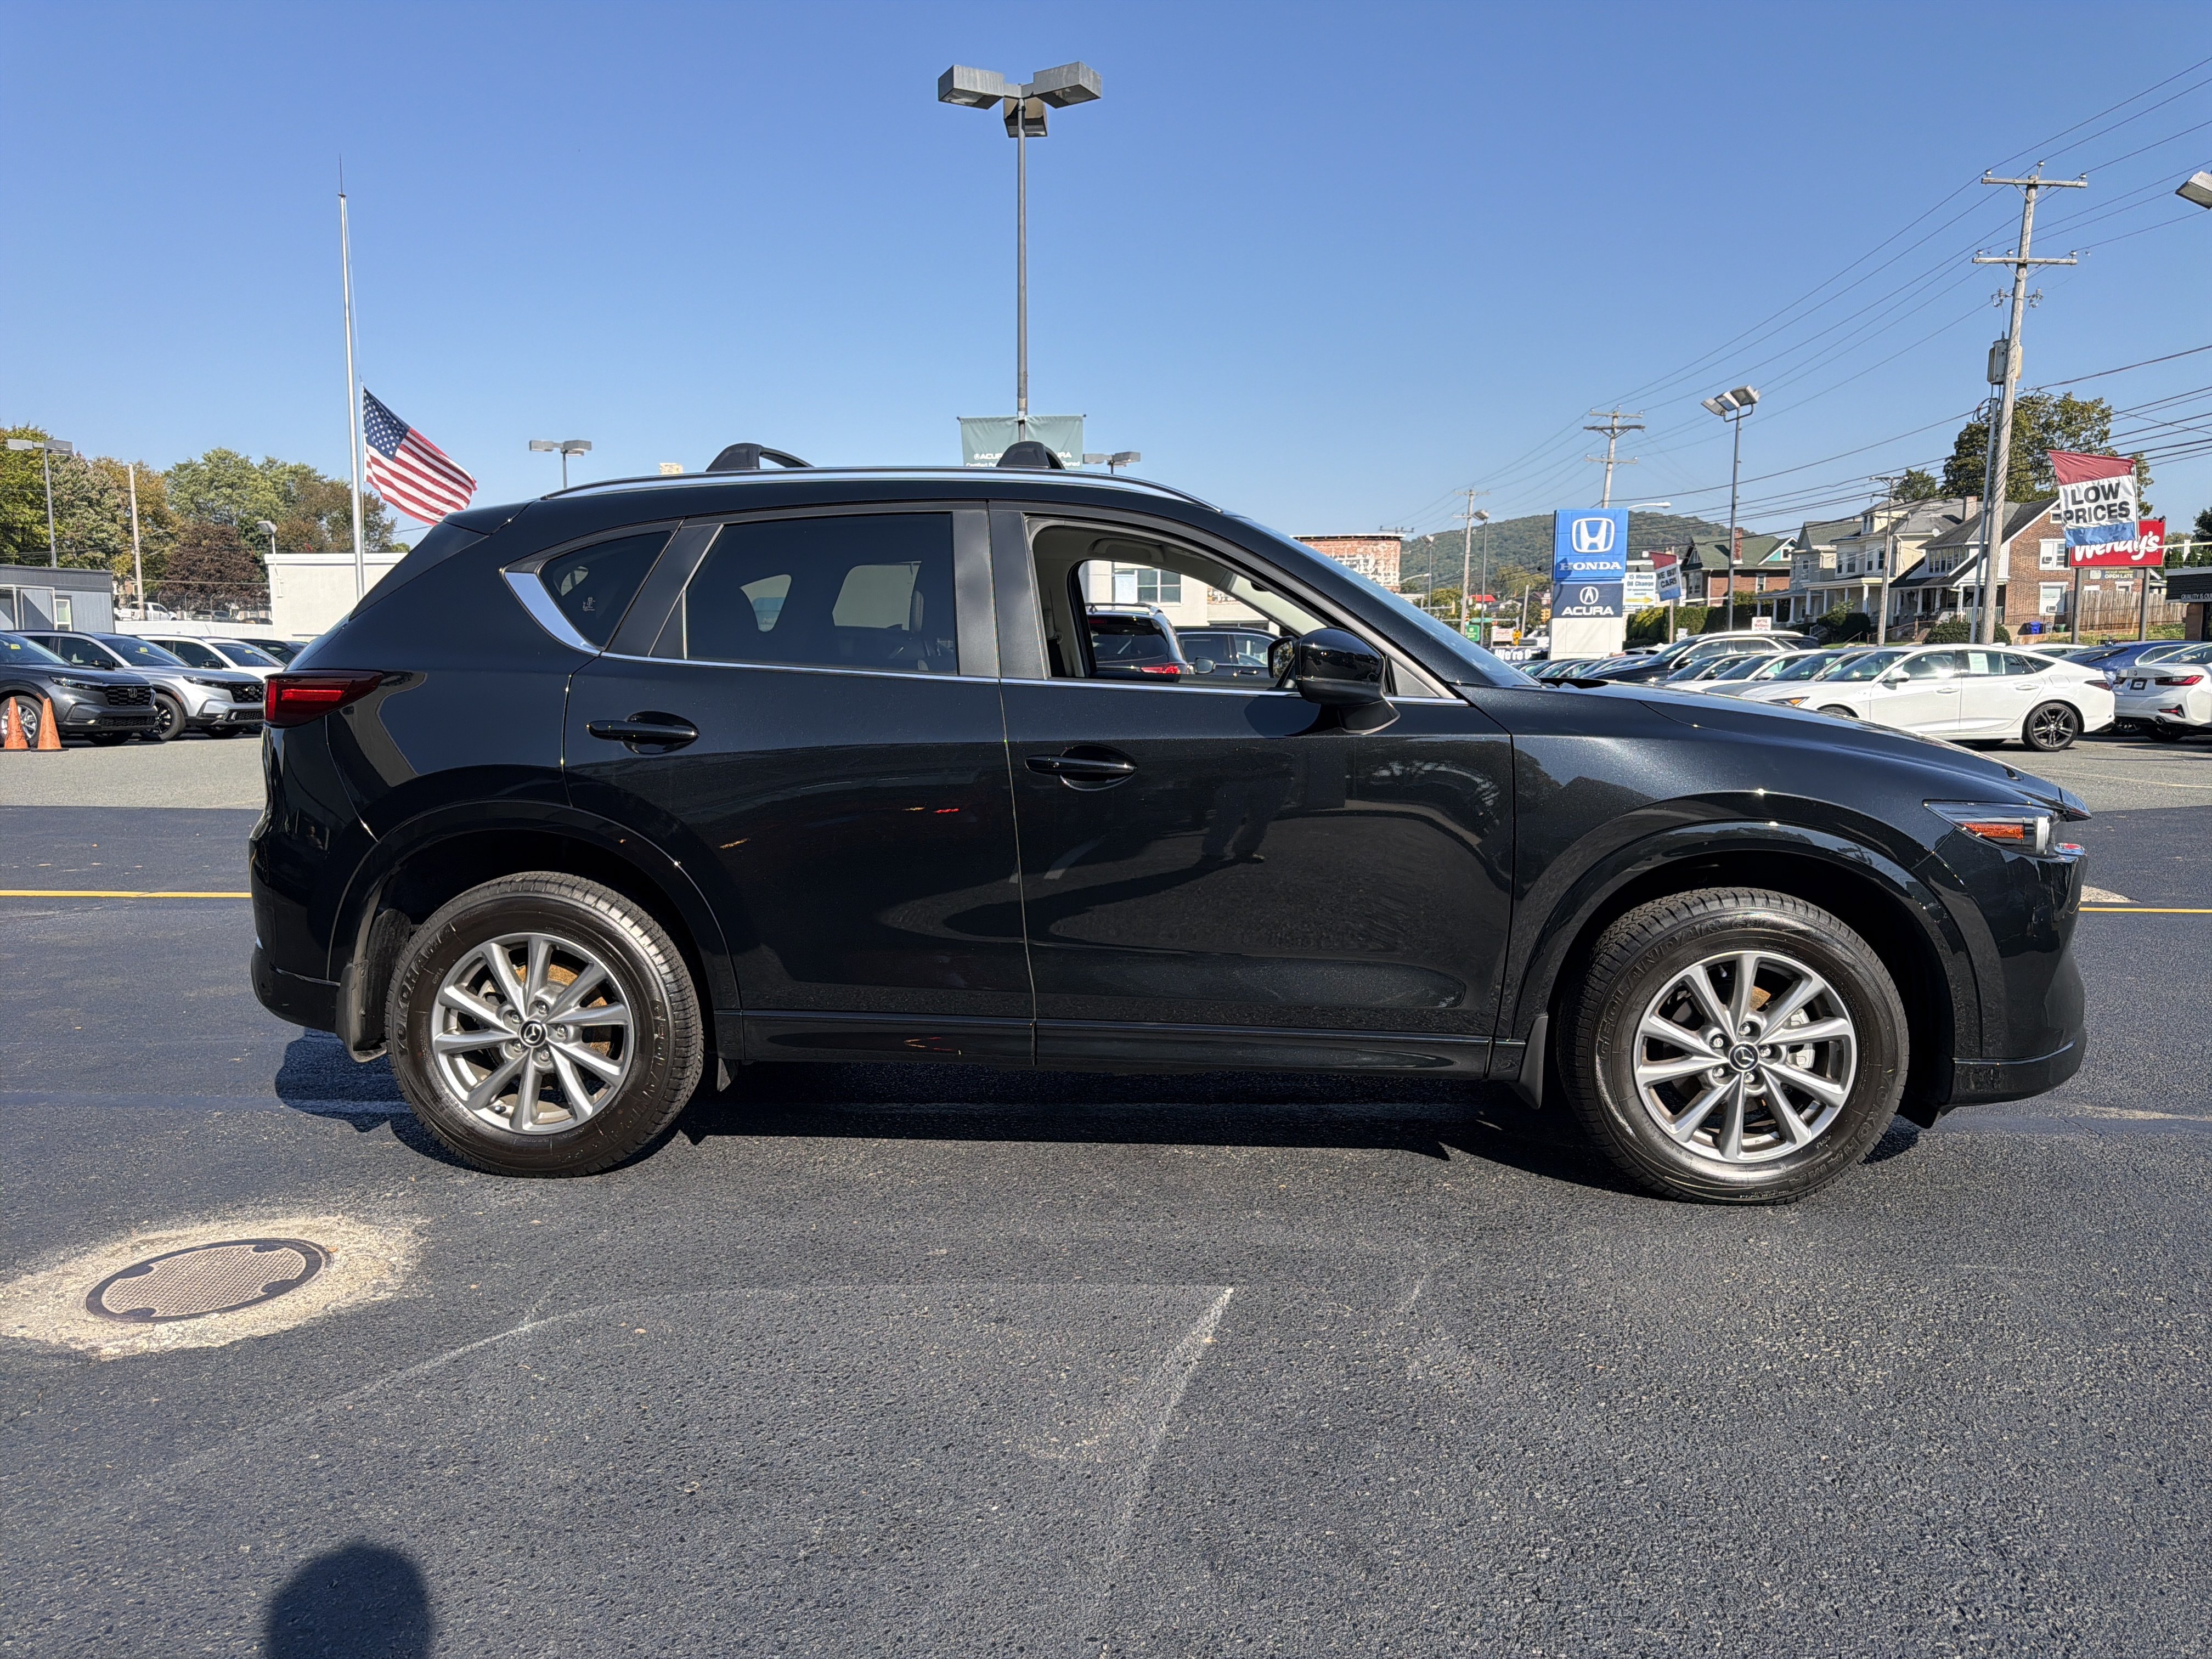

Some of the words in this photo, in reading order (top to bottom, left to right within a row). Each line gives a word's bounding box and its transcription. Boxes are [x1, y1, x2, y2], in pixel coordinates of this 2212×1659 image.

[2070, 482, 2120, 506] LOW
[2063, 501, 2131, 524] PRICES
[1559, 561, 1622, 571] HONDA
[1660, 577, 1677, 588] CARS
[1561, 606, 1614, 616] ACURA
[1495, 649, 1523, 661] We're
[397, 922, 456, 1056] YOKOHAMA
[1788, 1069, 1895, 1188] YOKOHAMA
